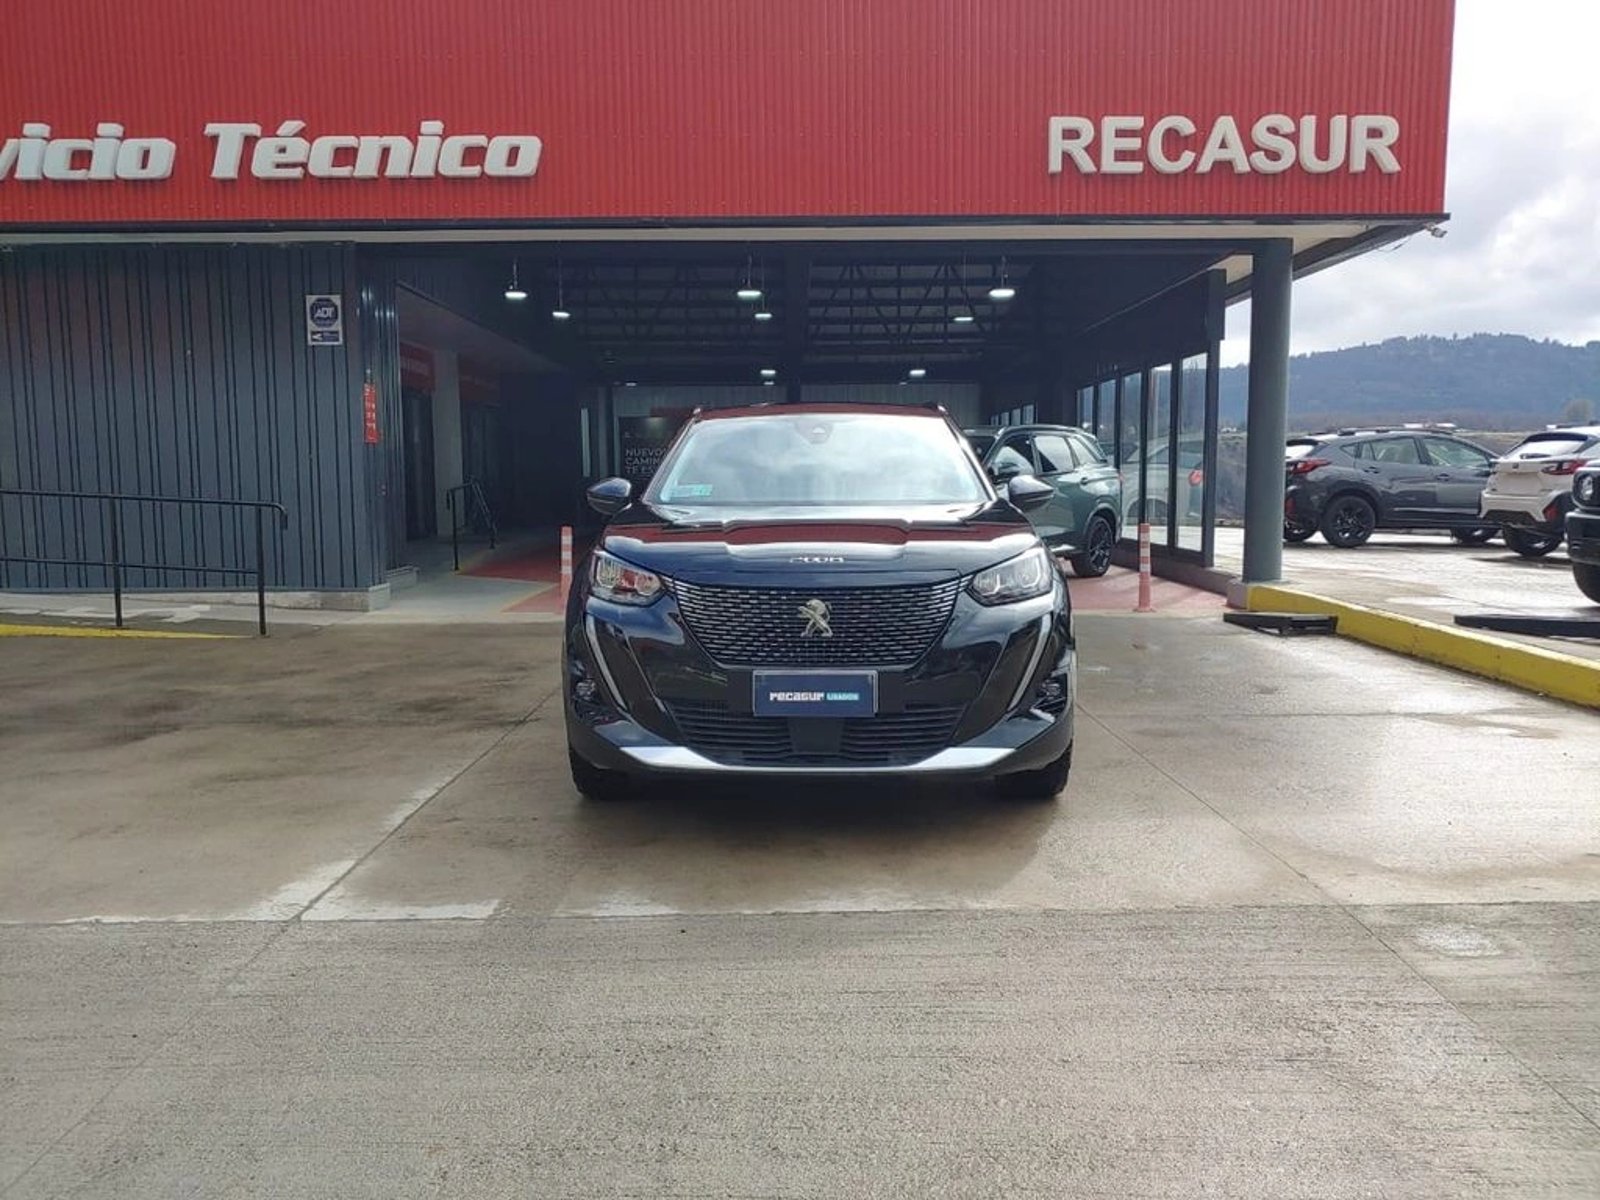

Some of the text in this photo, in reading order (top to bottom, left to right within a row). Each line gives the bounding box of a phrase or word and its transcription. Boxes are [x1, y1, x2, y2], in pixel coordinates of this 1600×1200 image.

[203, 120, 542, 179] Técnico
[1048, 113, 1402, 175] RECASUR
[314, 306, 335, 319] ADT
[625, 457, 660, 465] CAMIN
